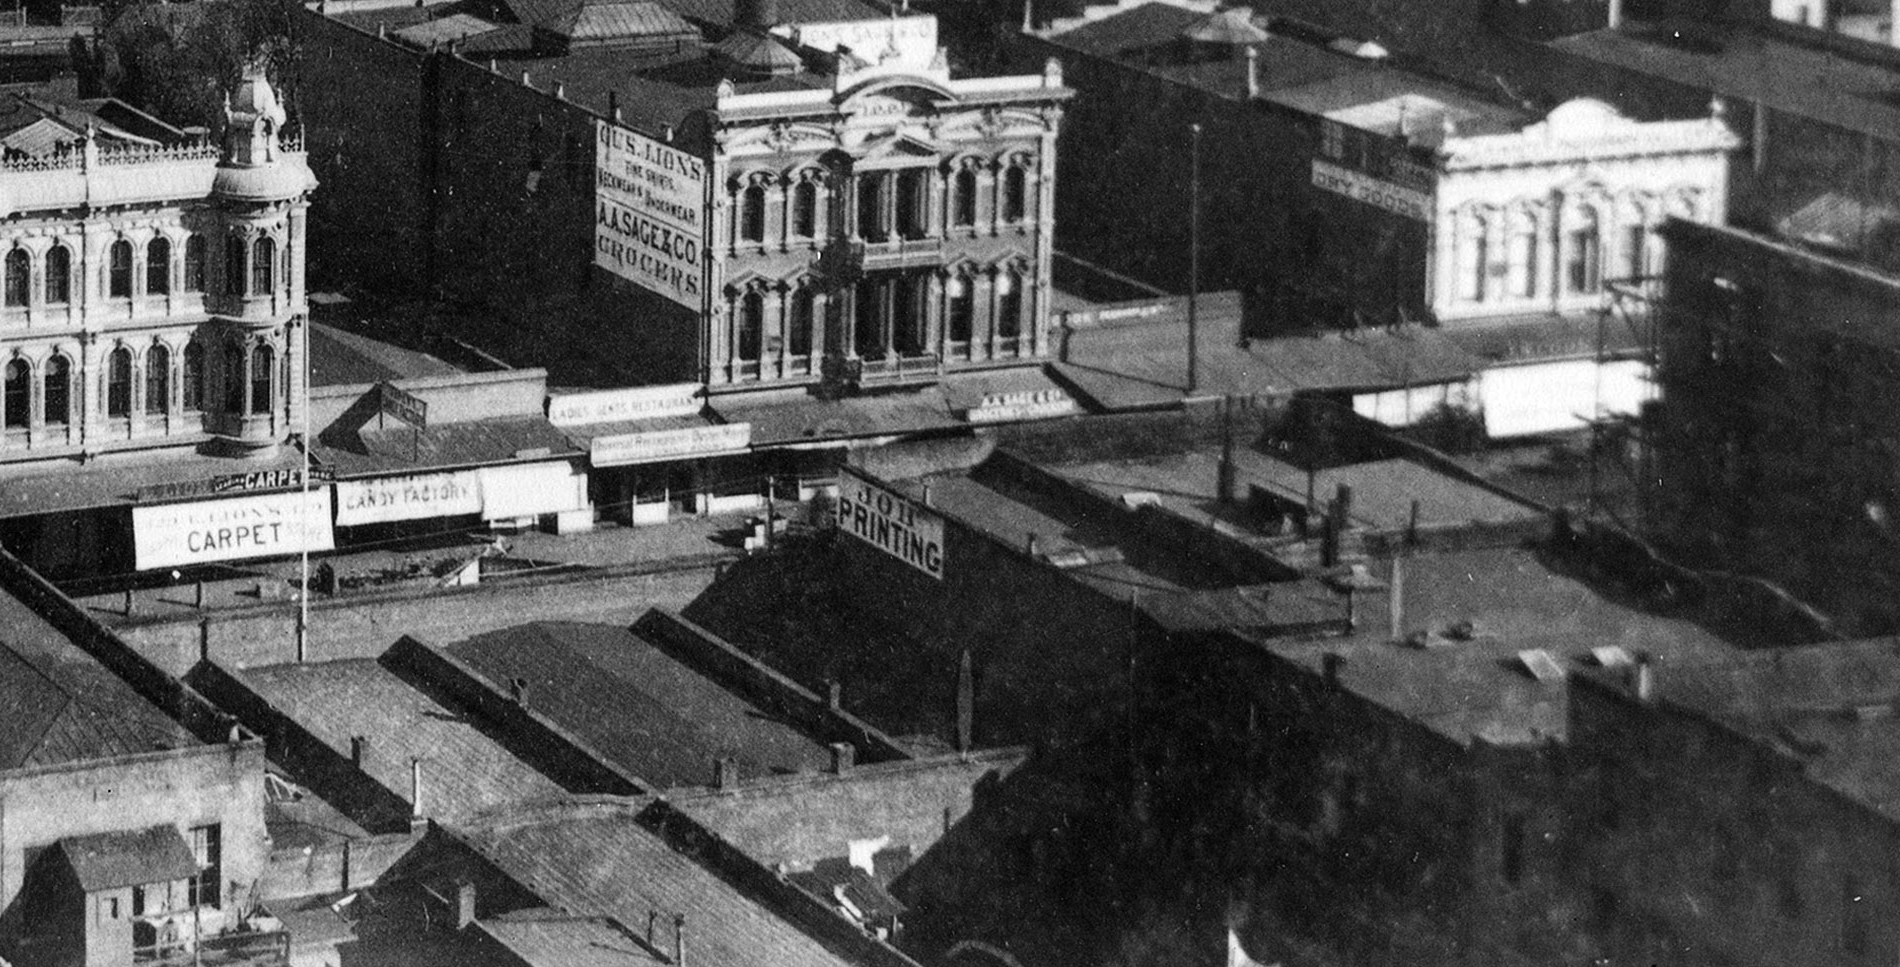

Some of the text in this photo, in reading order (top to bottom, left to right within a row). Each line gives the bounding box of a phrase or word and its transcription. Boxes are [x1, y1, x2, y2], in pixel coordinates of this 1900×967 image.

[245, 468, 305, 490] CARPET
[346, 488, 397, 511] CANDY
[187, 522, 282, 553] CARPET
[840, 496, 940, 572] PRINTING
